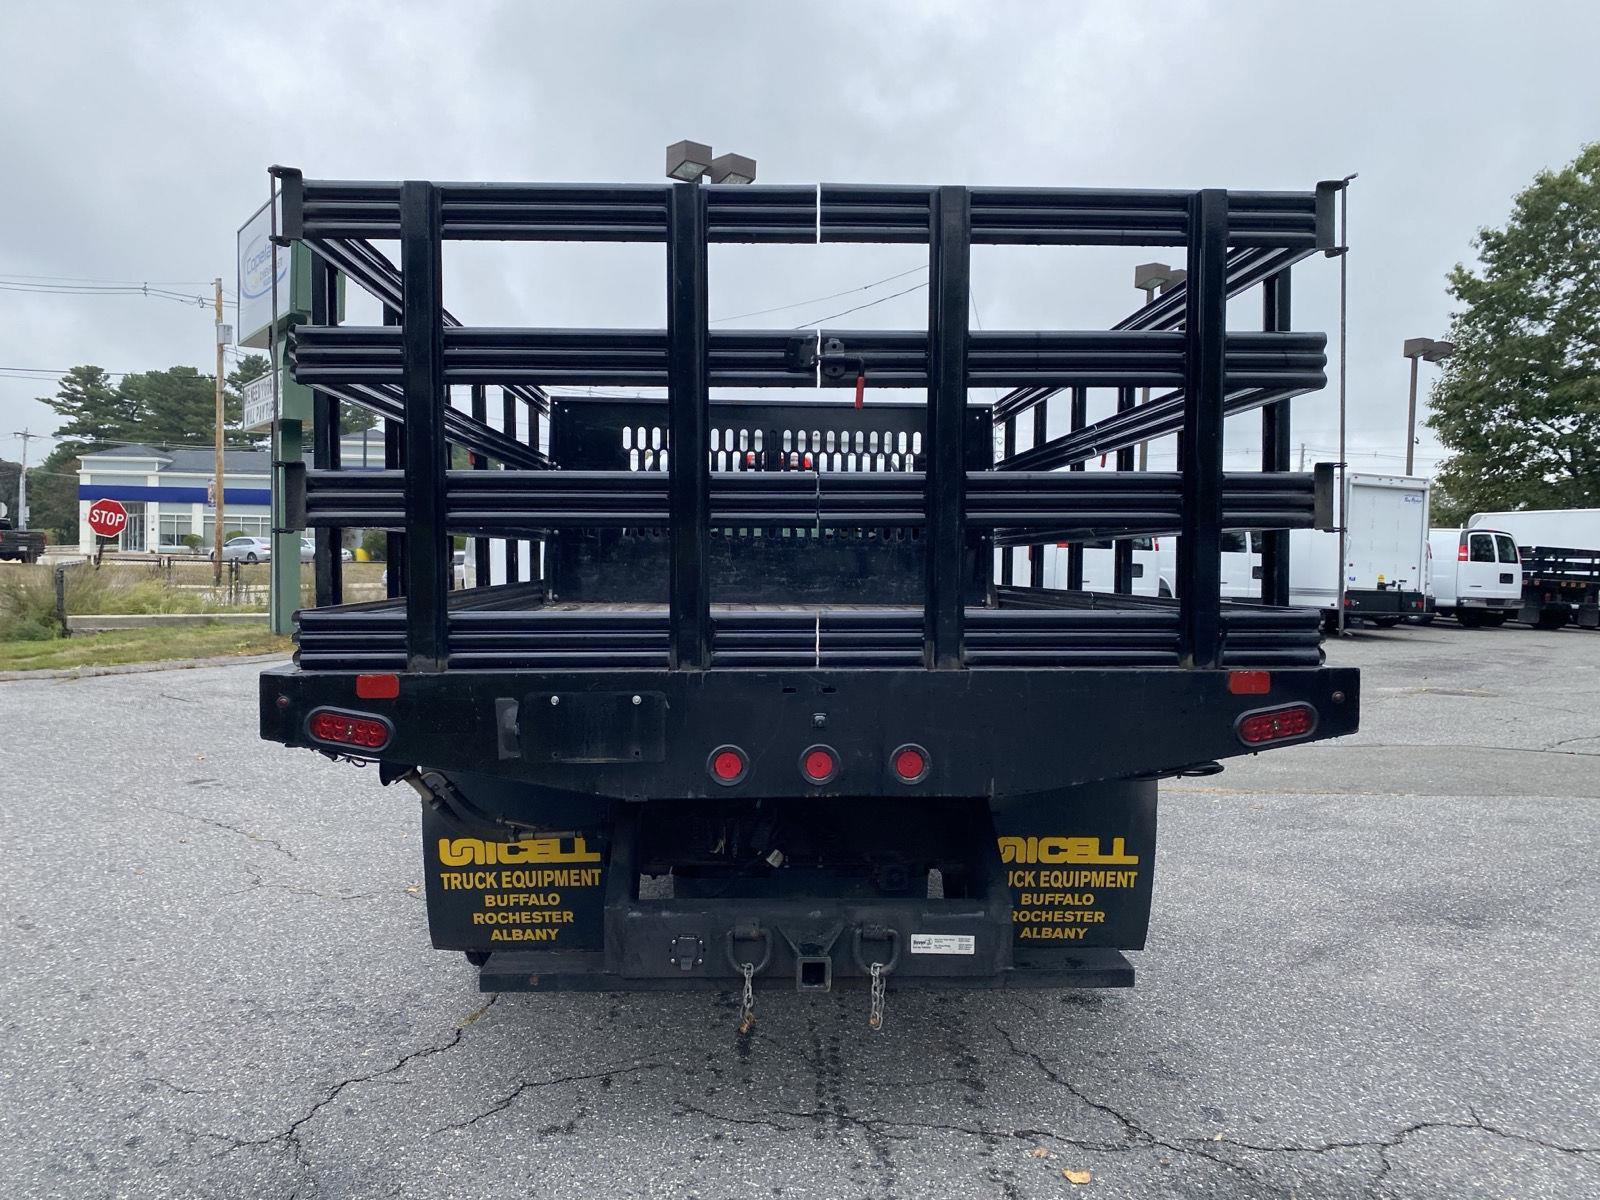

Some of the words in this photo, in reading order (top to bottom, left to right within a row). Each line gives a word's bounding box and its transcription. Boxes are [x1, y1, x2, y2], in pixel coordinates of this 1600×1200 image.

[90, 509, 125, 527] STOP
[438, 838, 601, 866] UNICELL
[998, 836, 1139, 865] NICELL
[440, 872, 498, 890] TRUCK
[502, 869, 601, 889] EQUIPMENT
[1040, 871, 1138, 888] EQUIPMENT
[484, 893, 561, 907] BUFFALO
[1021, 893, 1095, 906] BUFFALO
[474, 911, 574, 925] ROCHESTER
[491, 928, 559, 941] ALBANY
[1020, 927, 1088, 939] ALBANY
